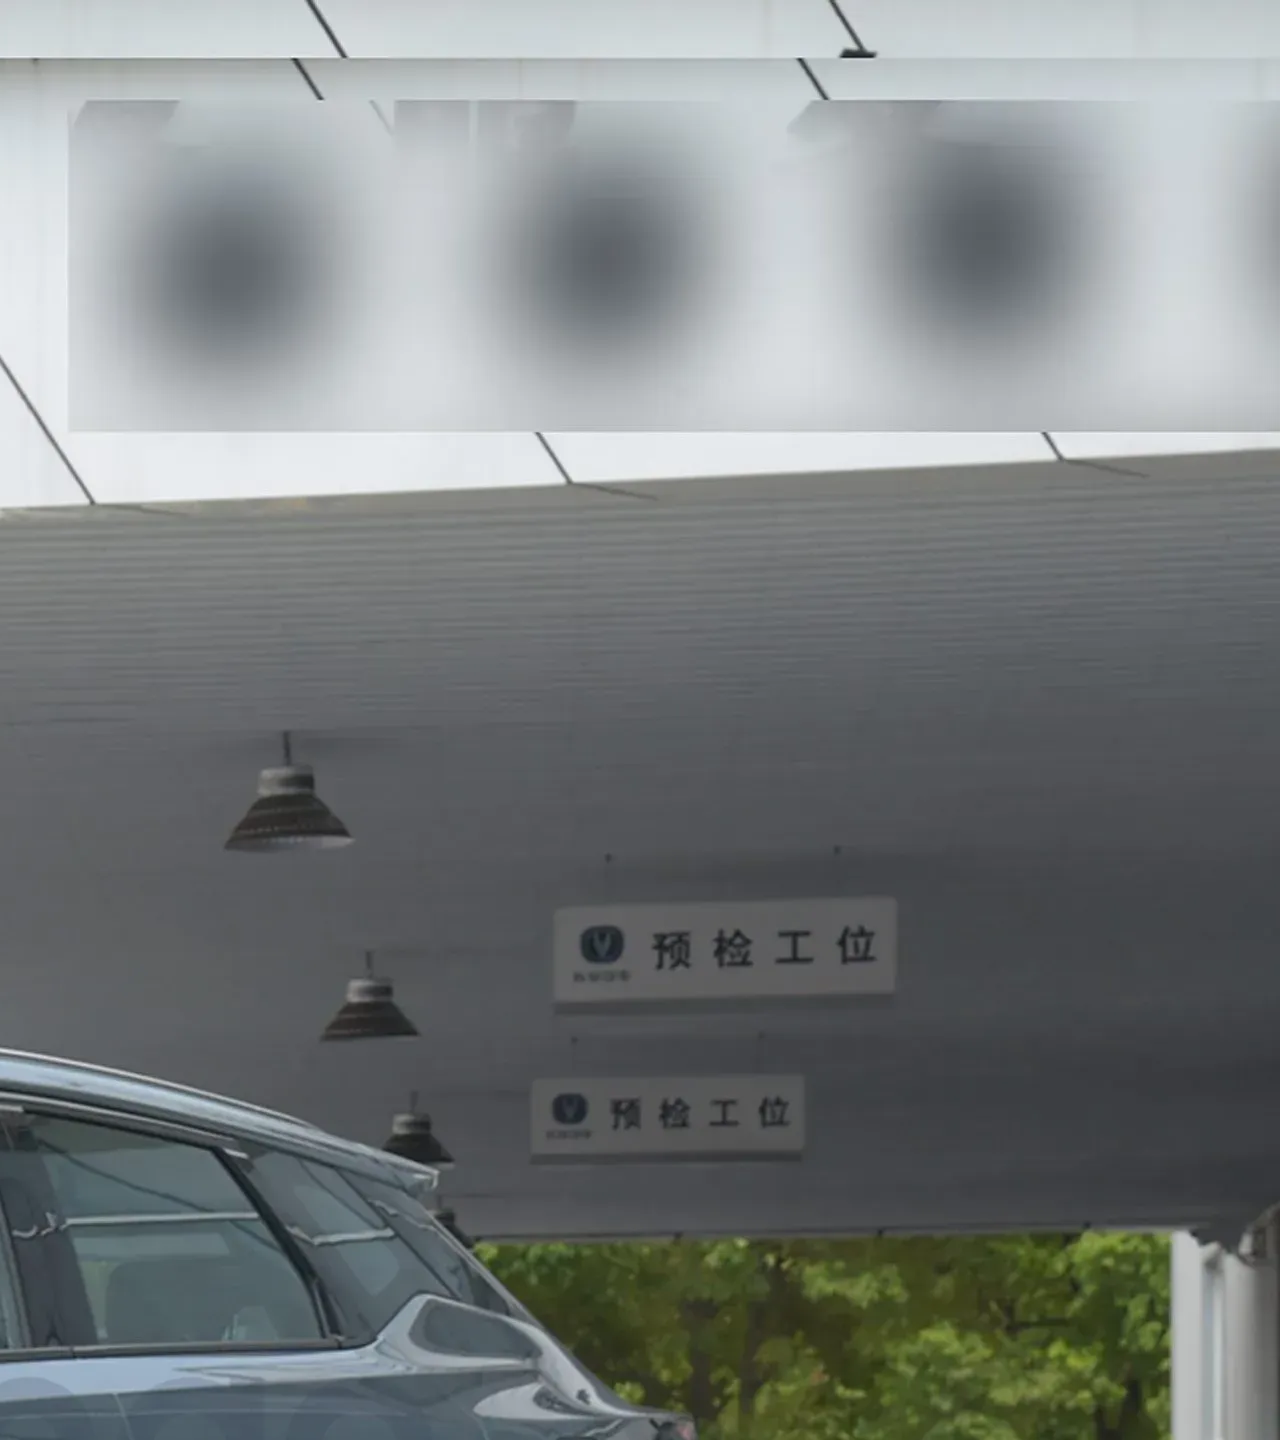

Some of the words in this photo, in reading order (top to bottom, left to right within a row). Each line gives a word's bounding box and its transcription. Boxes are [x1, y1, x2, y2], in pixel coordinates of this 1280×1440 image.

[652, 925, 877, 970] 预检工位
[610, 1096, 791, 1130] 预检工位
